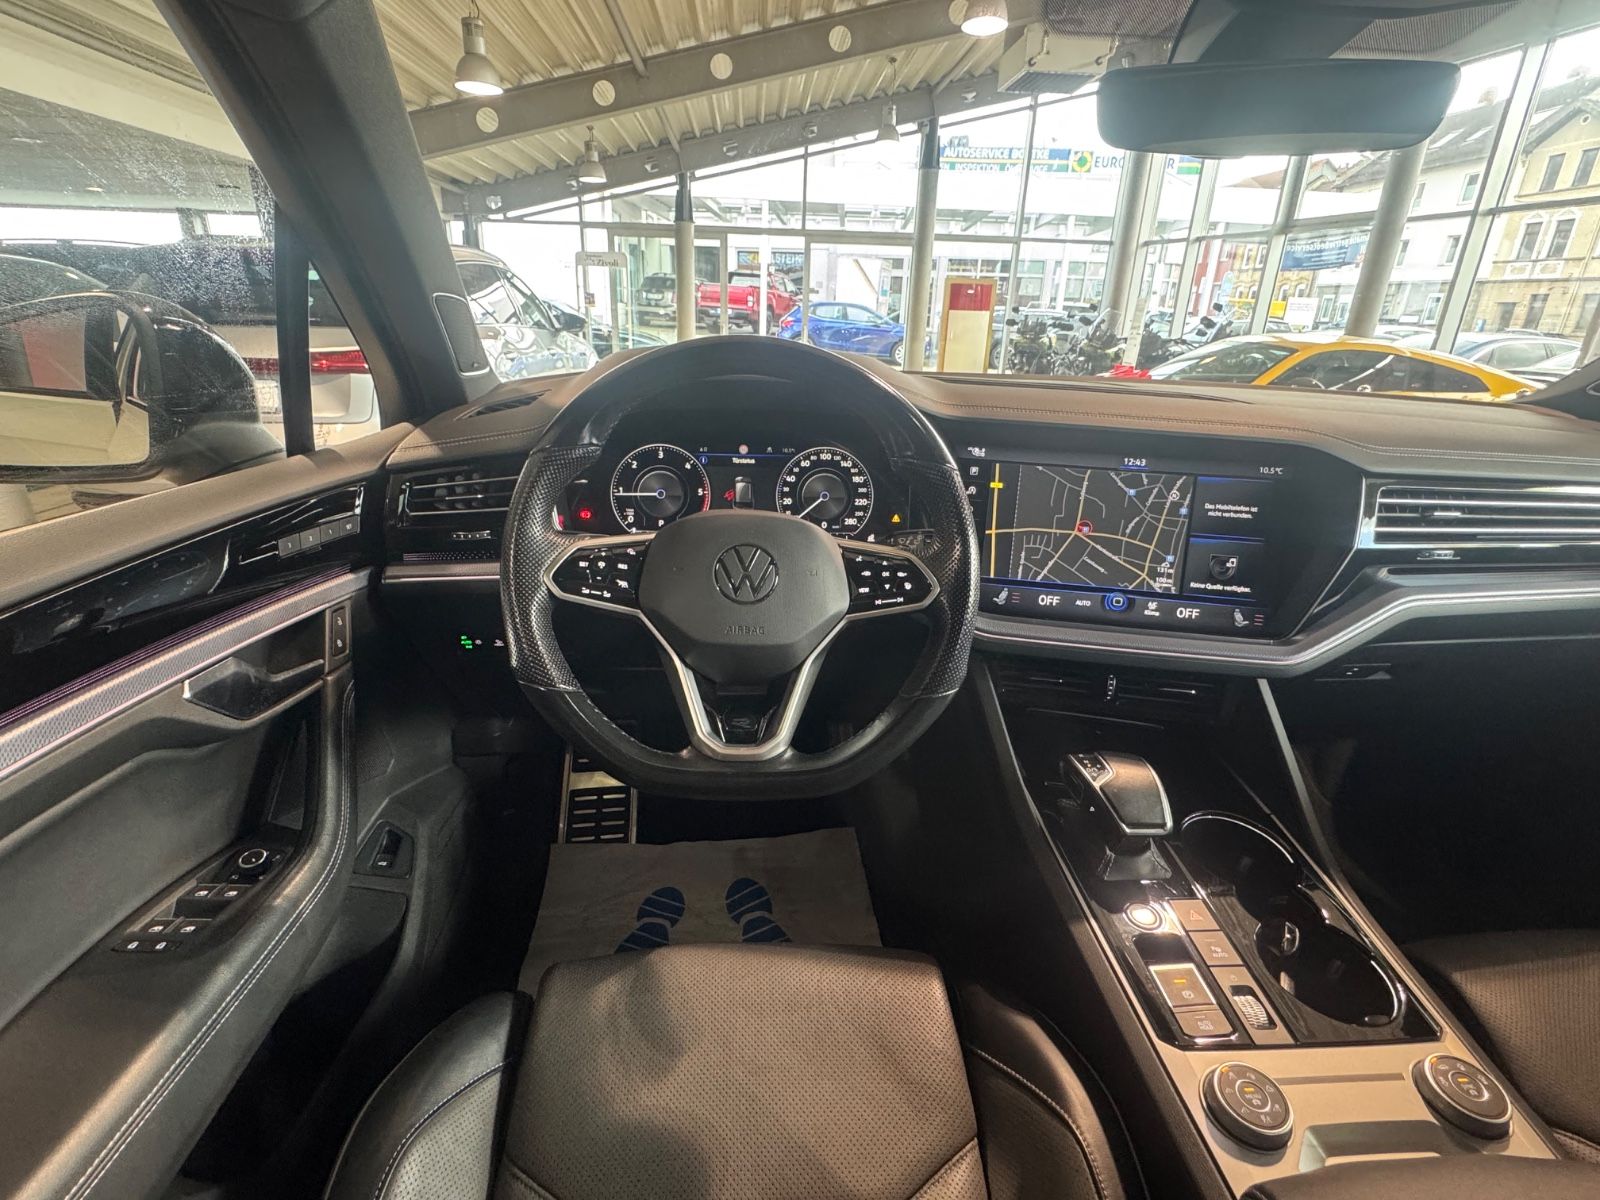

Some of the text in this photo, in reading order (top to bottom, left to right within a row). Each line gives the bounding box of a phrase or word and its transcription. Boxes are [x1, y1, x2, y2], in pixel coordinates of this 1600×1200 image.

[944, 147, 1010, 159] AUTOSERVICE
[1124, 458, 1146, 466] 12:43
[698, 488, 703, 496] 5
[628, 515, 634, 523] 0
[1038, 595, 1060, 606] OFF
[1176, 608, 1200, 619] OFF
[724, 626, 765, 635] AIRBAG
